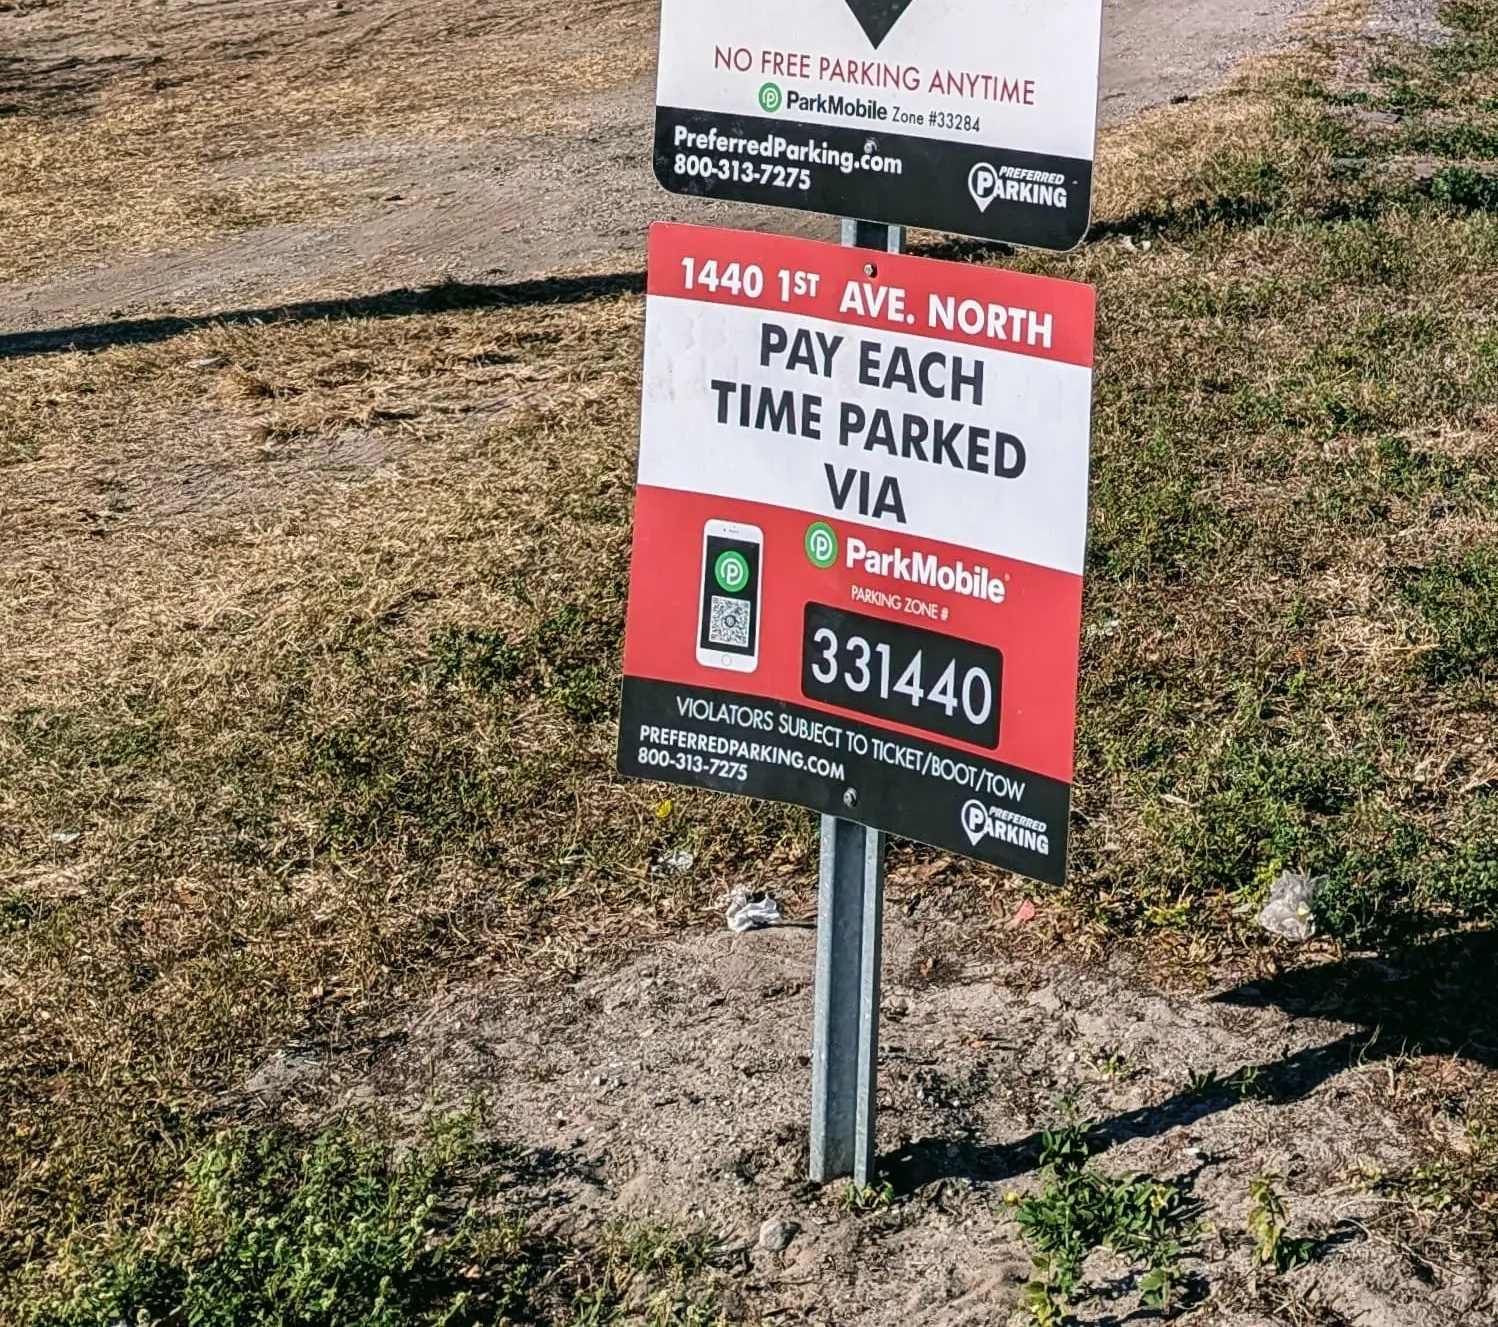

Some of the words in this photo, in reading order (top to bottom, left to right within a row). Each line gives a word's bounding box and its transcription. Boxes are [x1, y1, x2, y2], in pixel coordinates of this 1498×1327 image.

[715, 45, 753, 72] NO
[762, 50, 811, 78] FREE
[819, 57, 920, 91] PARKING
[928, 68, 1035, 105] ANYTIME
[787, 89, 888, 120] ParkMobile
[892, 106, 924, 125] Zone
[929, 110, 981, 133] #33284
[673, 154, 812, 190] 800-313-7275
[674, 125, 903, 174] PreferredParking.com
[999, 165, 1065, 185] PREFERRED
[977, 171, 1068, 209] PARKING
[681, 257, 764, 298] 1440
[778, 269, 820, 302] 1ST
[840, 280, 916, 325] AVE.
[928, 293, 1053, 349] NORTH
[760, 322, 844, 377] PAY
[859, 339, 984, 406] EACH
[711, 379, 822, 441] TIME
[838, 401, 1027, 480] PARKED
[823, 462, 907, 524] VIA
[846, 536, 1006, 604] ParkMobile
[851, 585, 901, 611] PARKING
[904, 598, 938, 620] ZONE
[940, 607, 949, 621] #
[811, 627, 992, 725] 331440
[637, 746, 748, 782] 800-313-7275
[639, 724, 846, 782] PREFERREDPARKING.COM
[676, 695, 774, 732] VIOLATORS
[778, 713, 843, 749] SUBJECT
[846, 731, 868, 755] TO
[871, 738, 1026, 802] TICKET/BOOT/TOW
[969, 807, 1049, 855] PARKING
[988, 805, 1047, 832] PREFERRED
